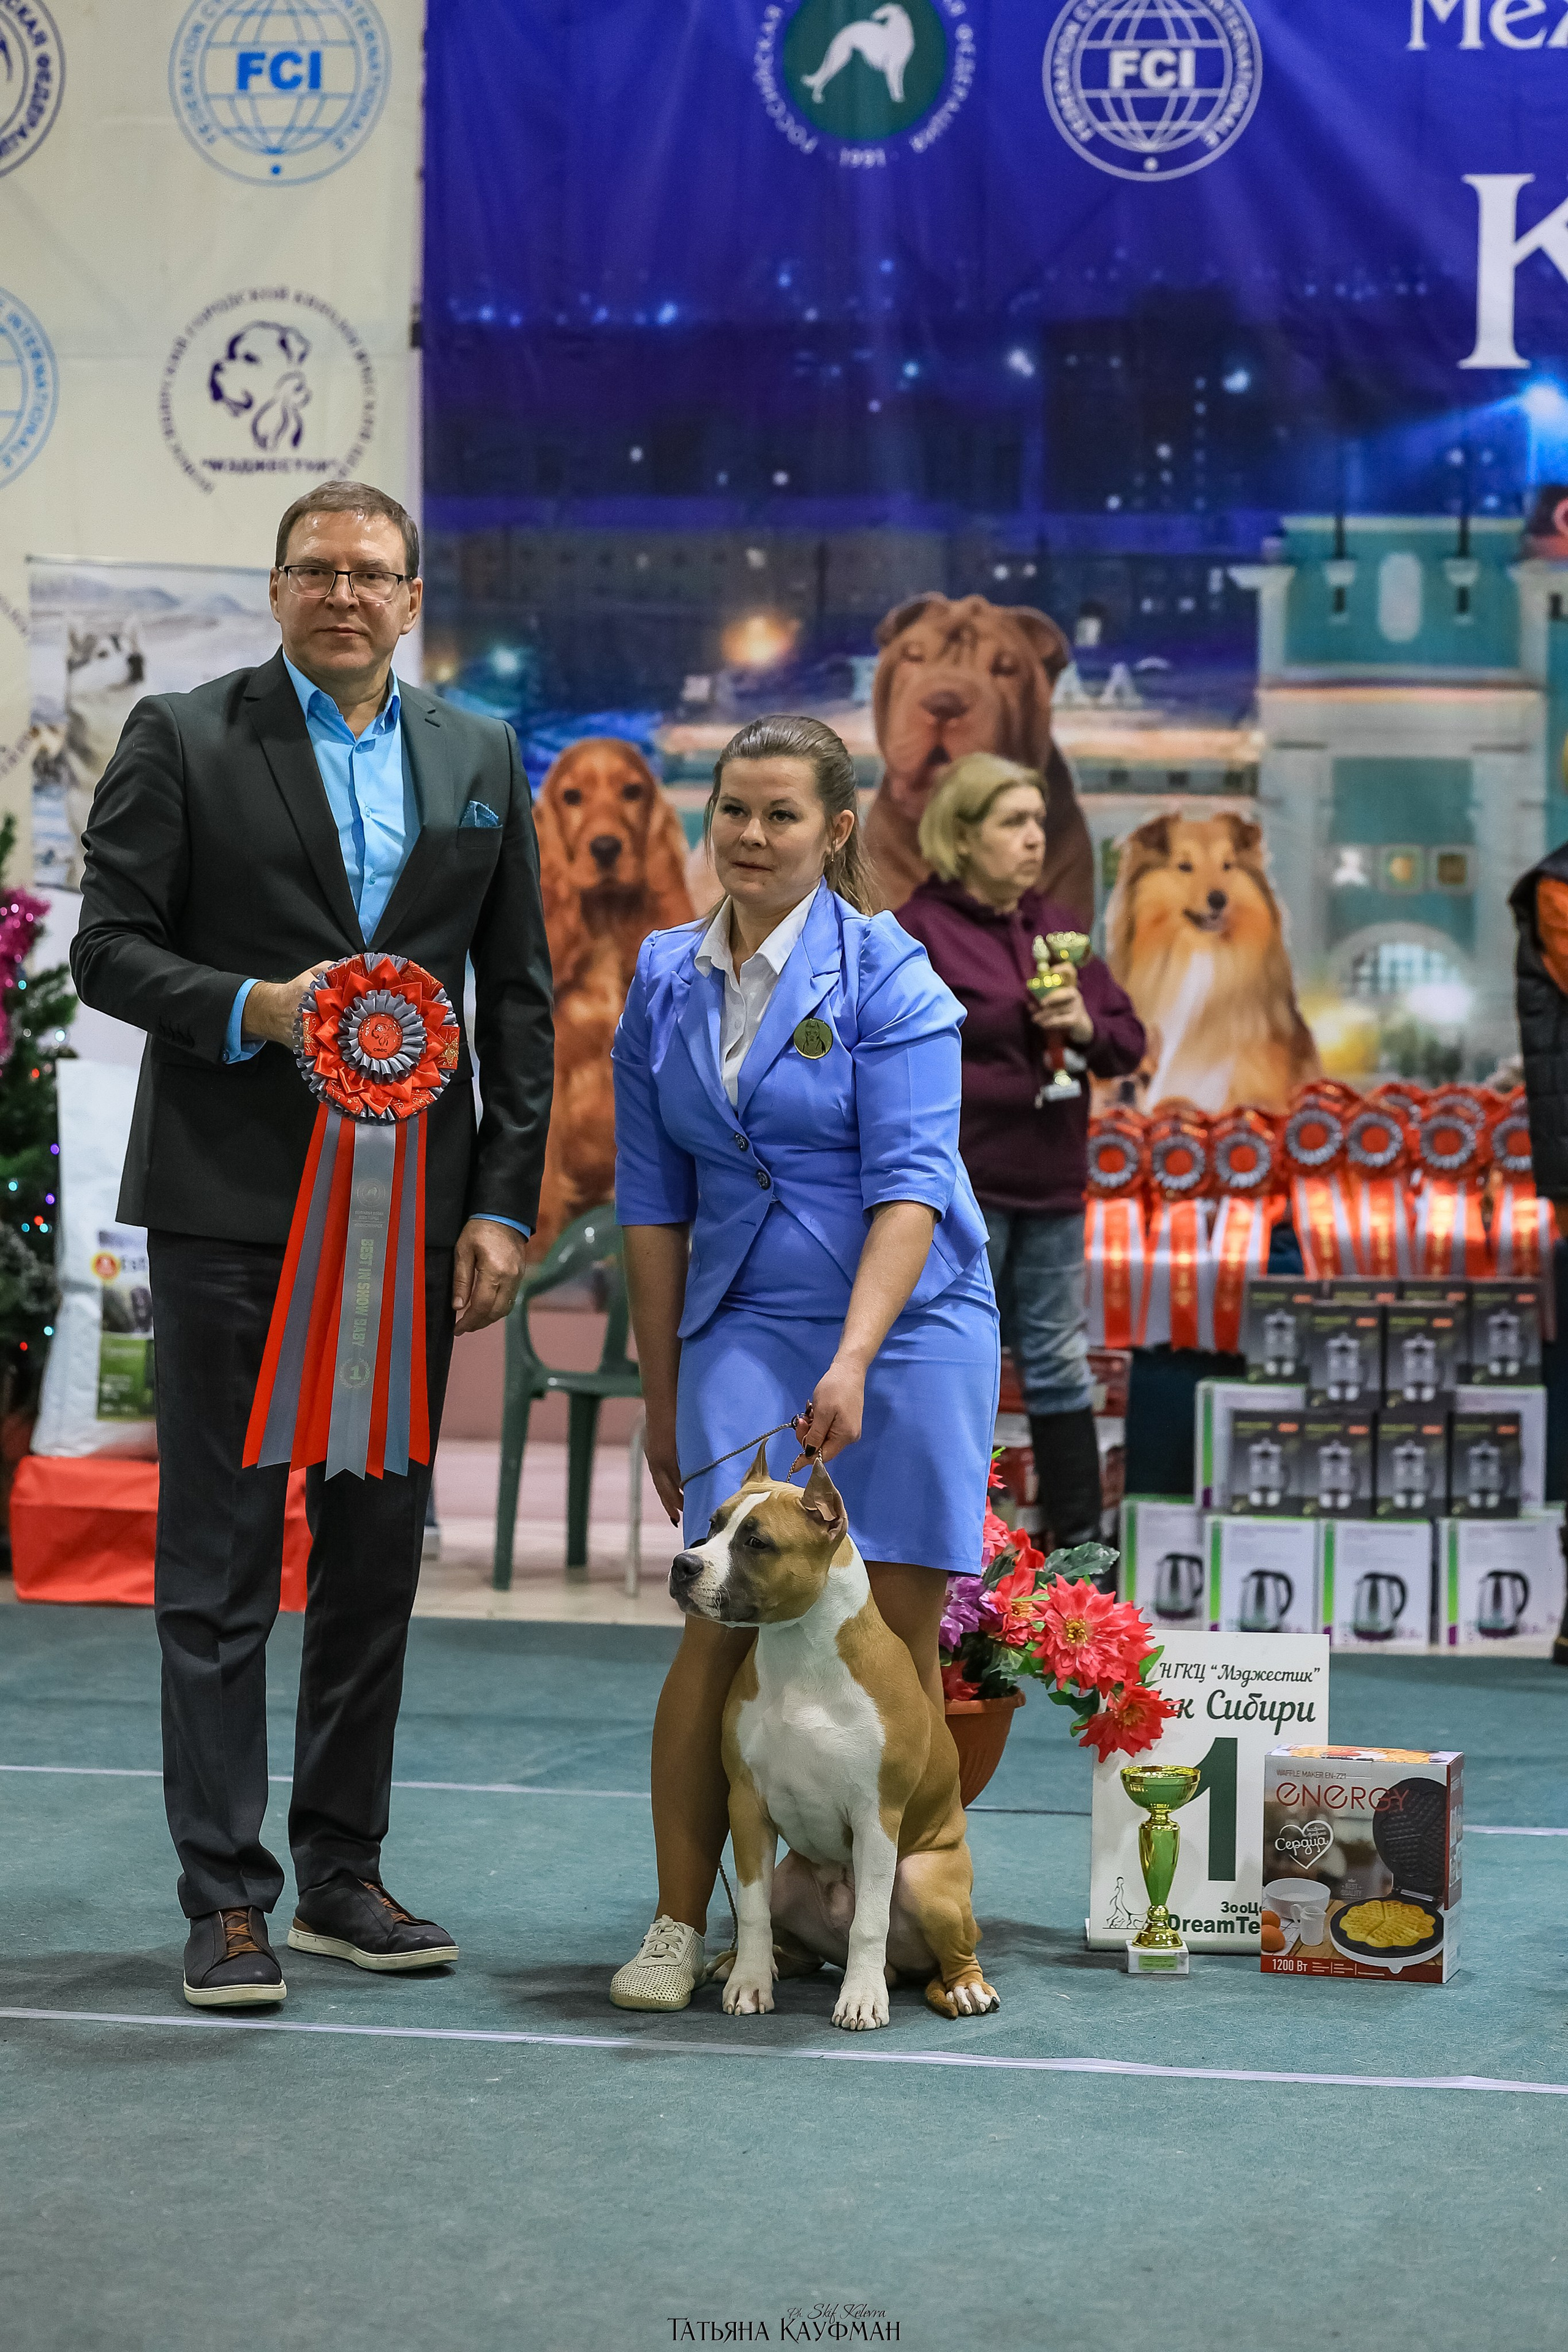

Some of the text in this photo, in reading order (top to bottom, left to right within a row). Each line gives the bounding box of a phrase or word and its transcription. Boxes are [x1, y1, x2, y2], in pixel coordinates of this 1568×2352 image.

[237, 50, 322, 91] FCI
[1109, 49, 1196, 89] FCI
[360, 1238, 374, 1266] BEST
[358, 1268, 372, 1280] IN
[355, 1282, 371, 1316] SHOW
[352, 1318, 368, 1348] BABY
[350, 1365, 361, 1380] 1
[1159, 1662, 1206, 1683] НГКЦ
[1207, 1689, 1316, 1736] Сибири
[1276, 1769, 1300, 1778] WAFFLE
[1302, 1770, 1324, 1779] MAKER
[1187, 1737, 1238, 1882] 1
[1275, 1837, 1330, 1856] Сердца
[1272, 1958, 1294, 1971] 1200
[1297, 1959, 1308, 1972] Вт
